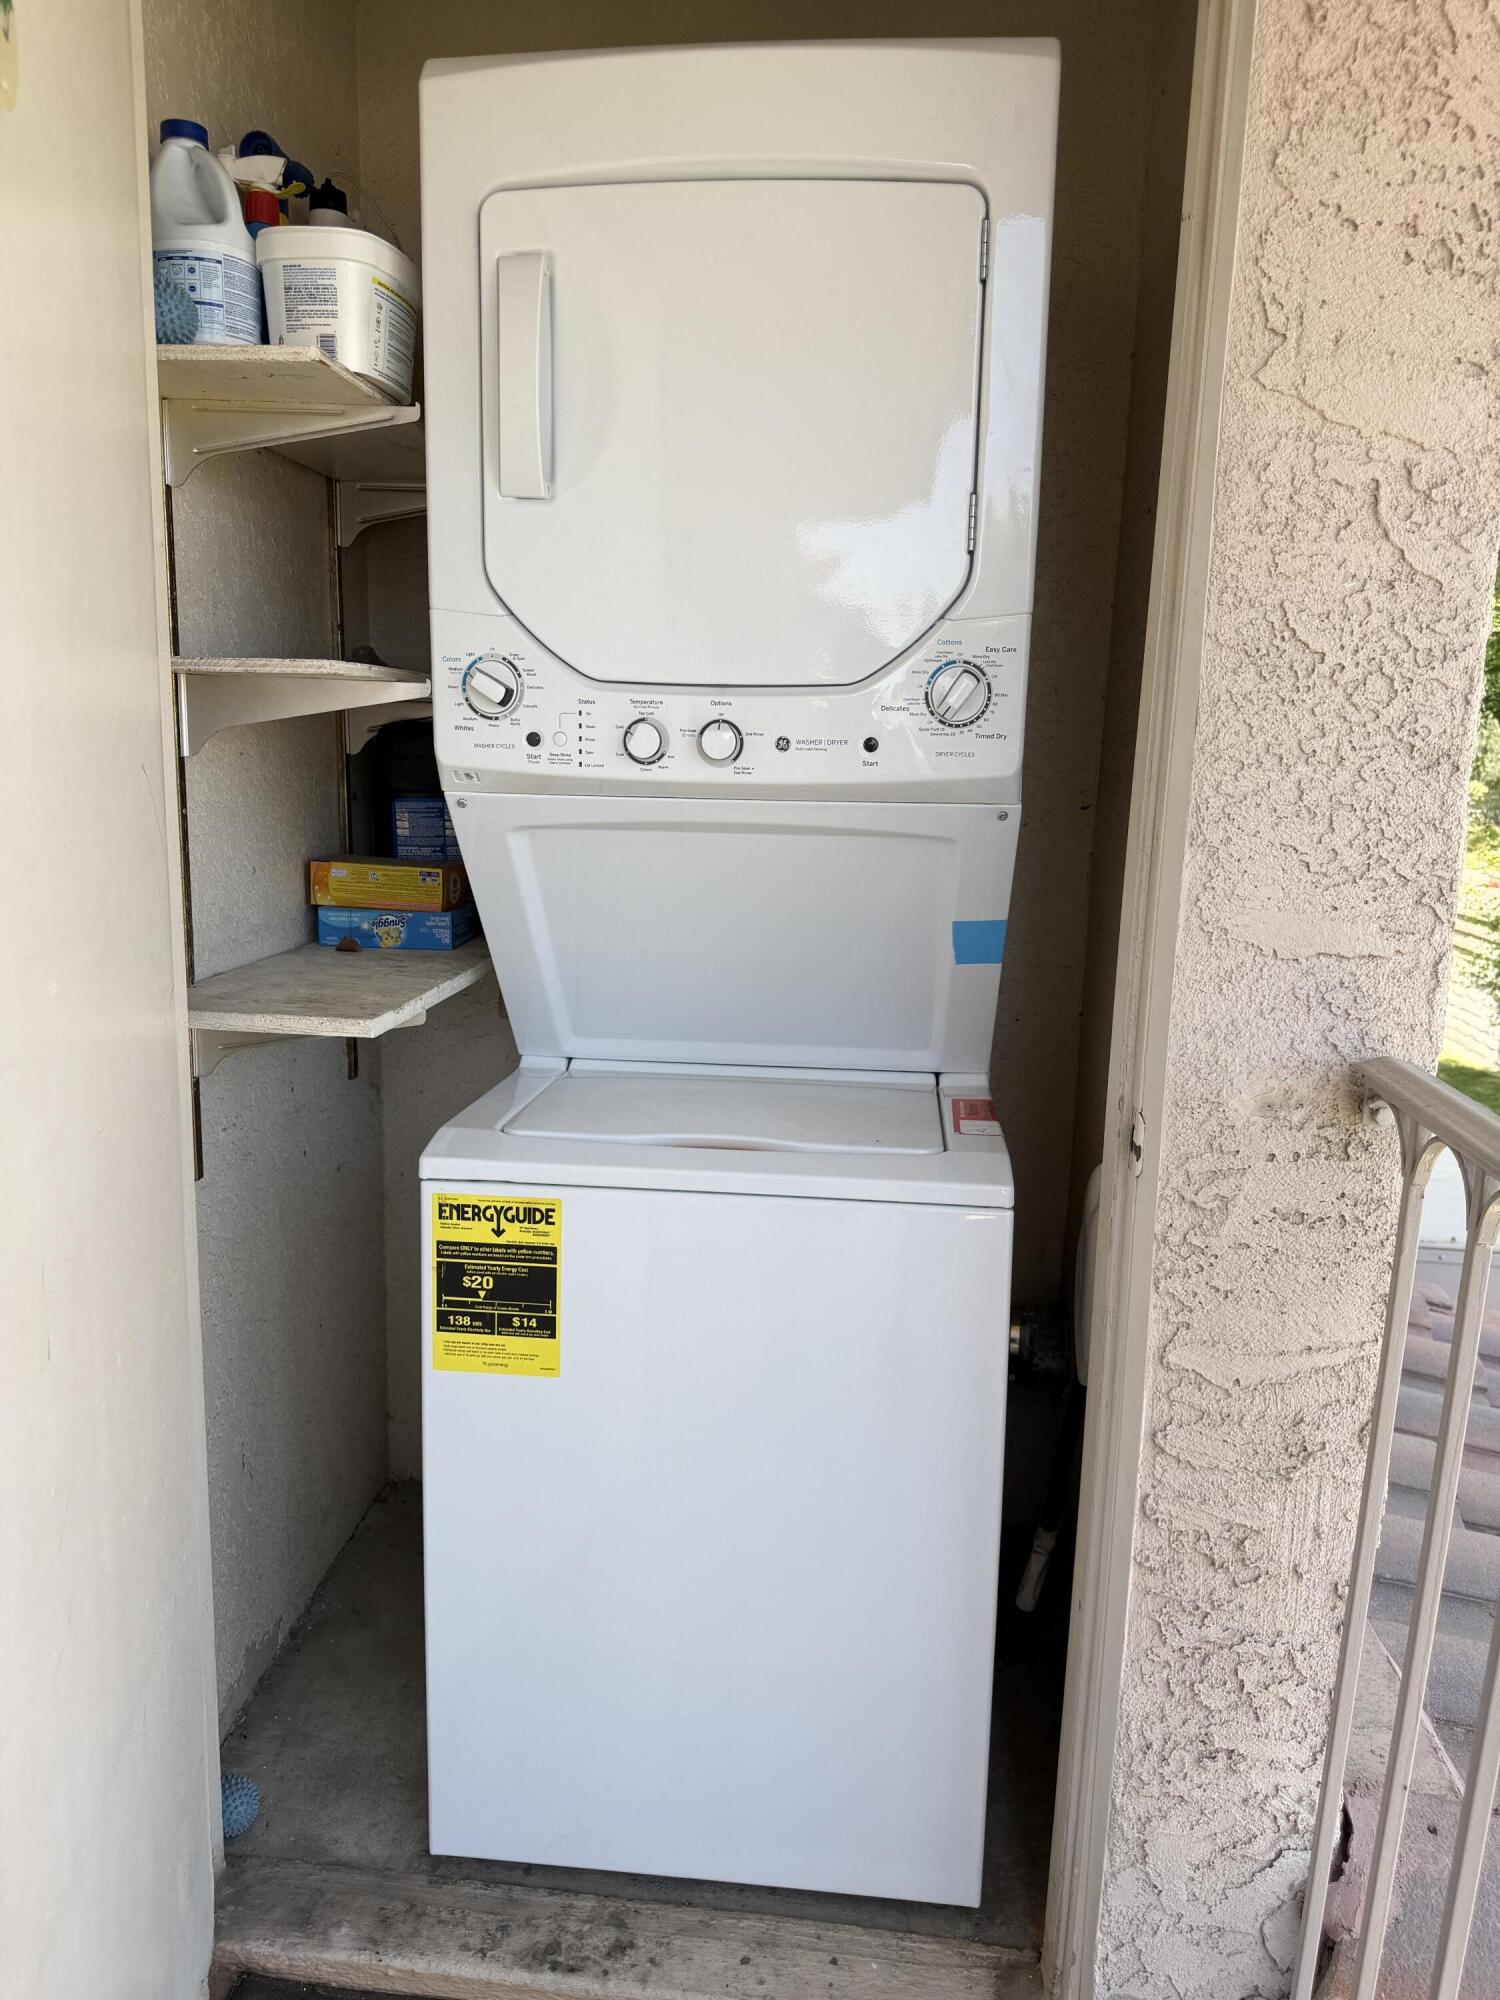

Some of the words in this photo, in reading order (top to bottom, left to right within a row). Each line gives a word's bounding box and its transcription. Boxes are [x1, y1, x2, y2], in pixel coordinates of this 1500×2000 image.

[996, 733, 1007, 741] Dry
[371, 916, 408, 930] Snuggle
[438, 1202, 556, 1226] ENERGYGUIDE
[462, 1275, 494, 1289] $20
[447, 1315, 471, 1326] 138
[512, 1316, 537, 1328] $14
